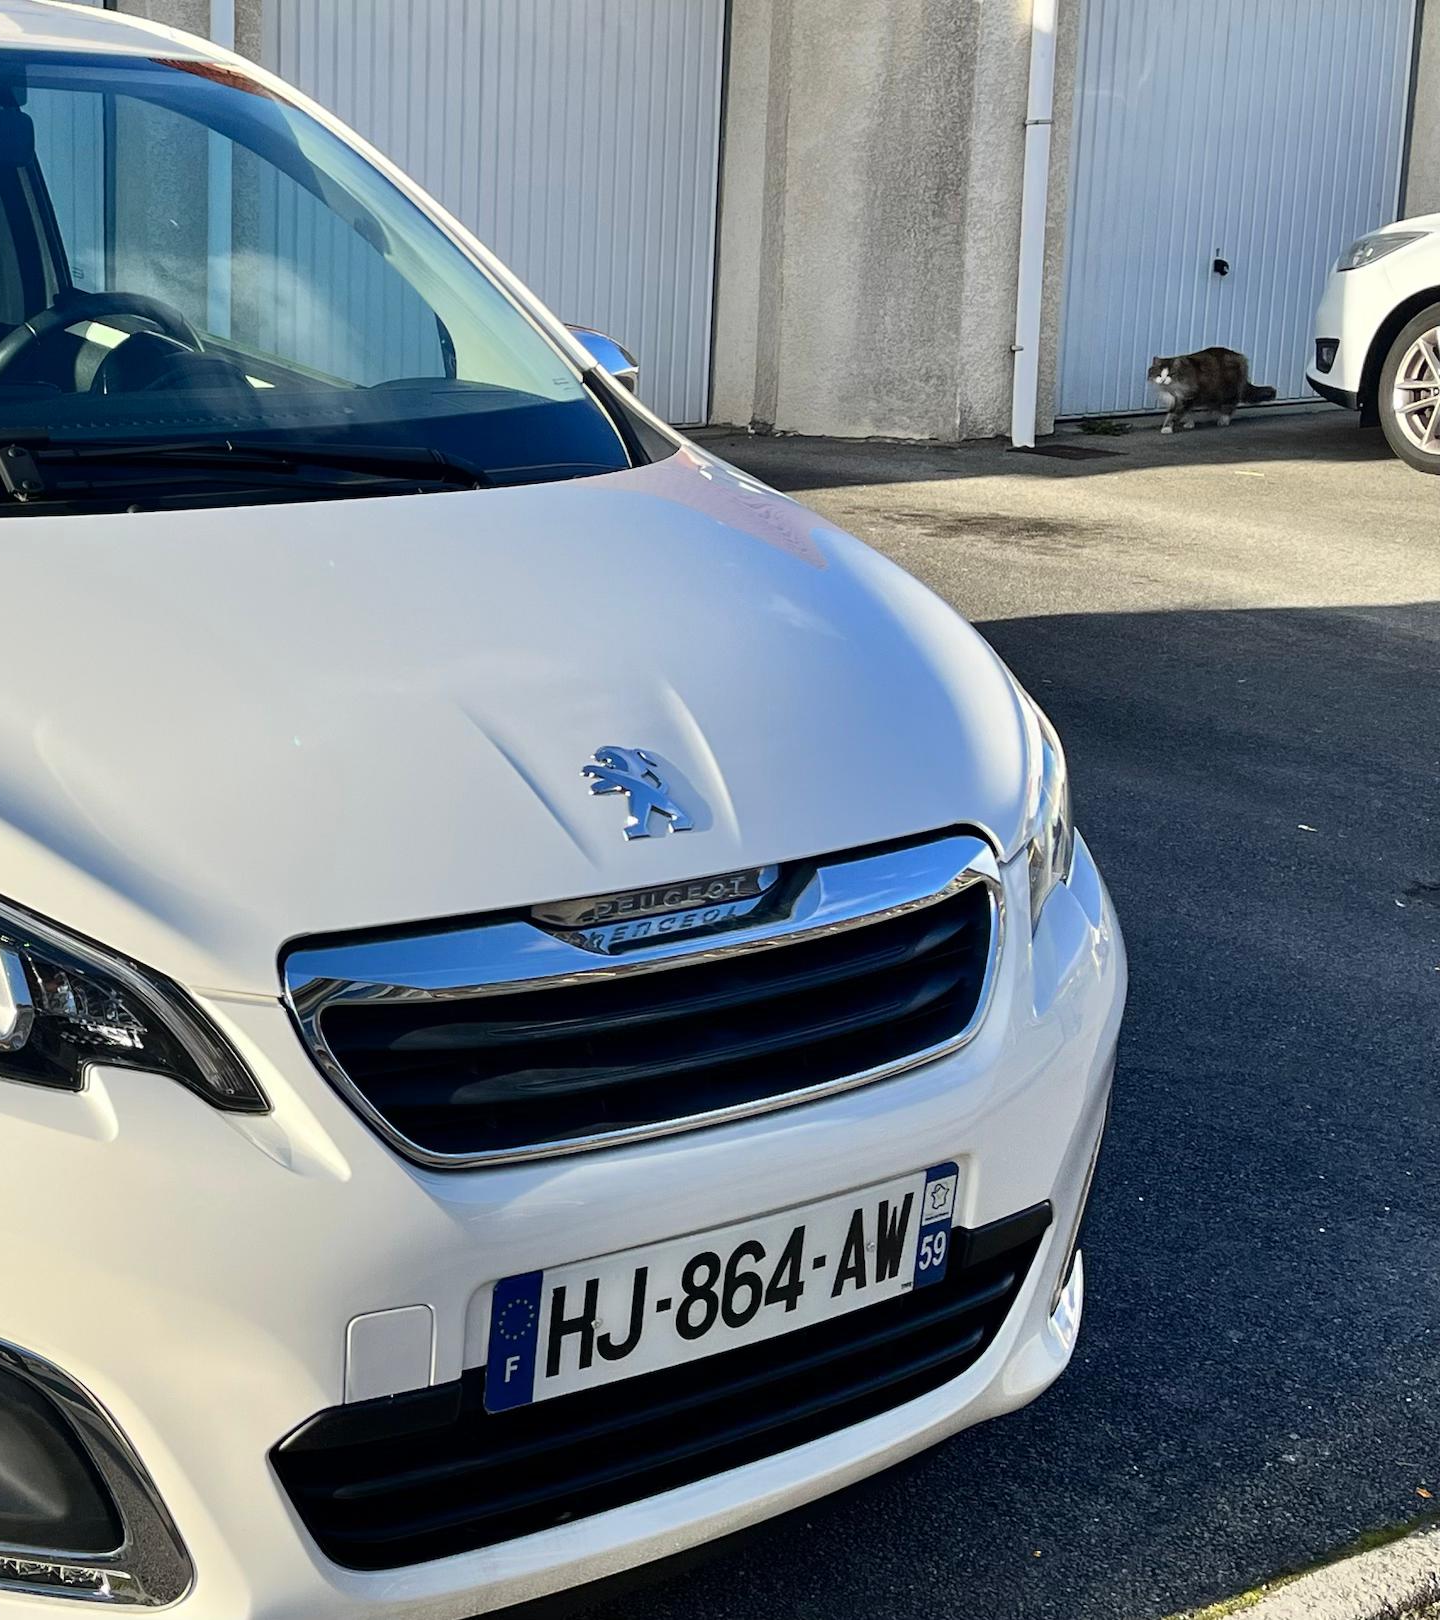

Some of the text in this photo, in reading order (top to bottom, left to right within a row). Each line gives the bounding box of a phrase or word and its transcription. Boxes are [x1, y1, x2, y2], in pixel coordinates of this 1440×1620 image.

[594, 877, 746, 918] PEUGEOT
[918, 1230, 947, 1271] 59
[545, 1191, 915, 1379] HJ-864-AW
[503, 1355, 520, 1384] F
